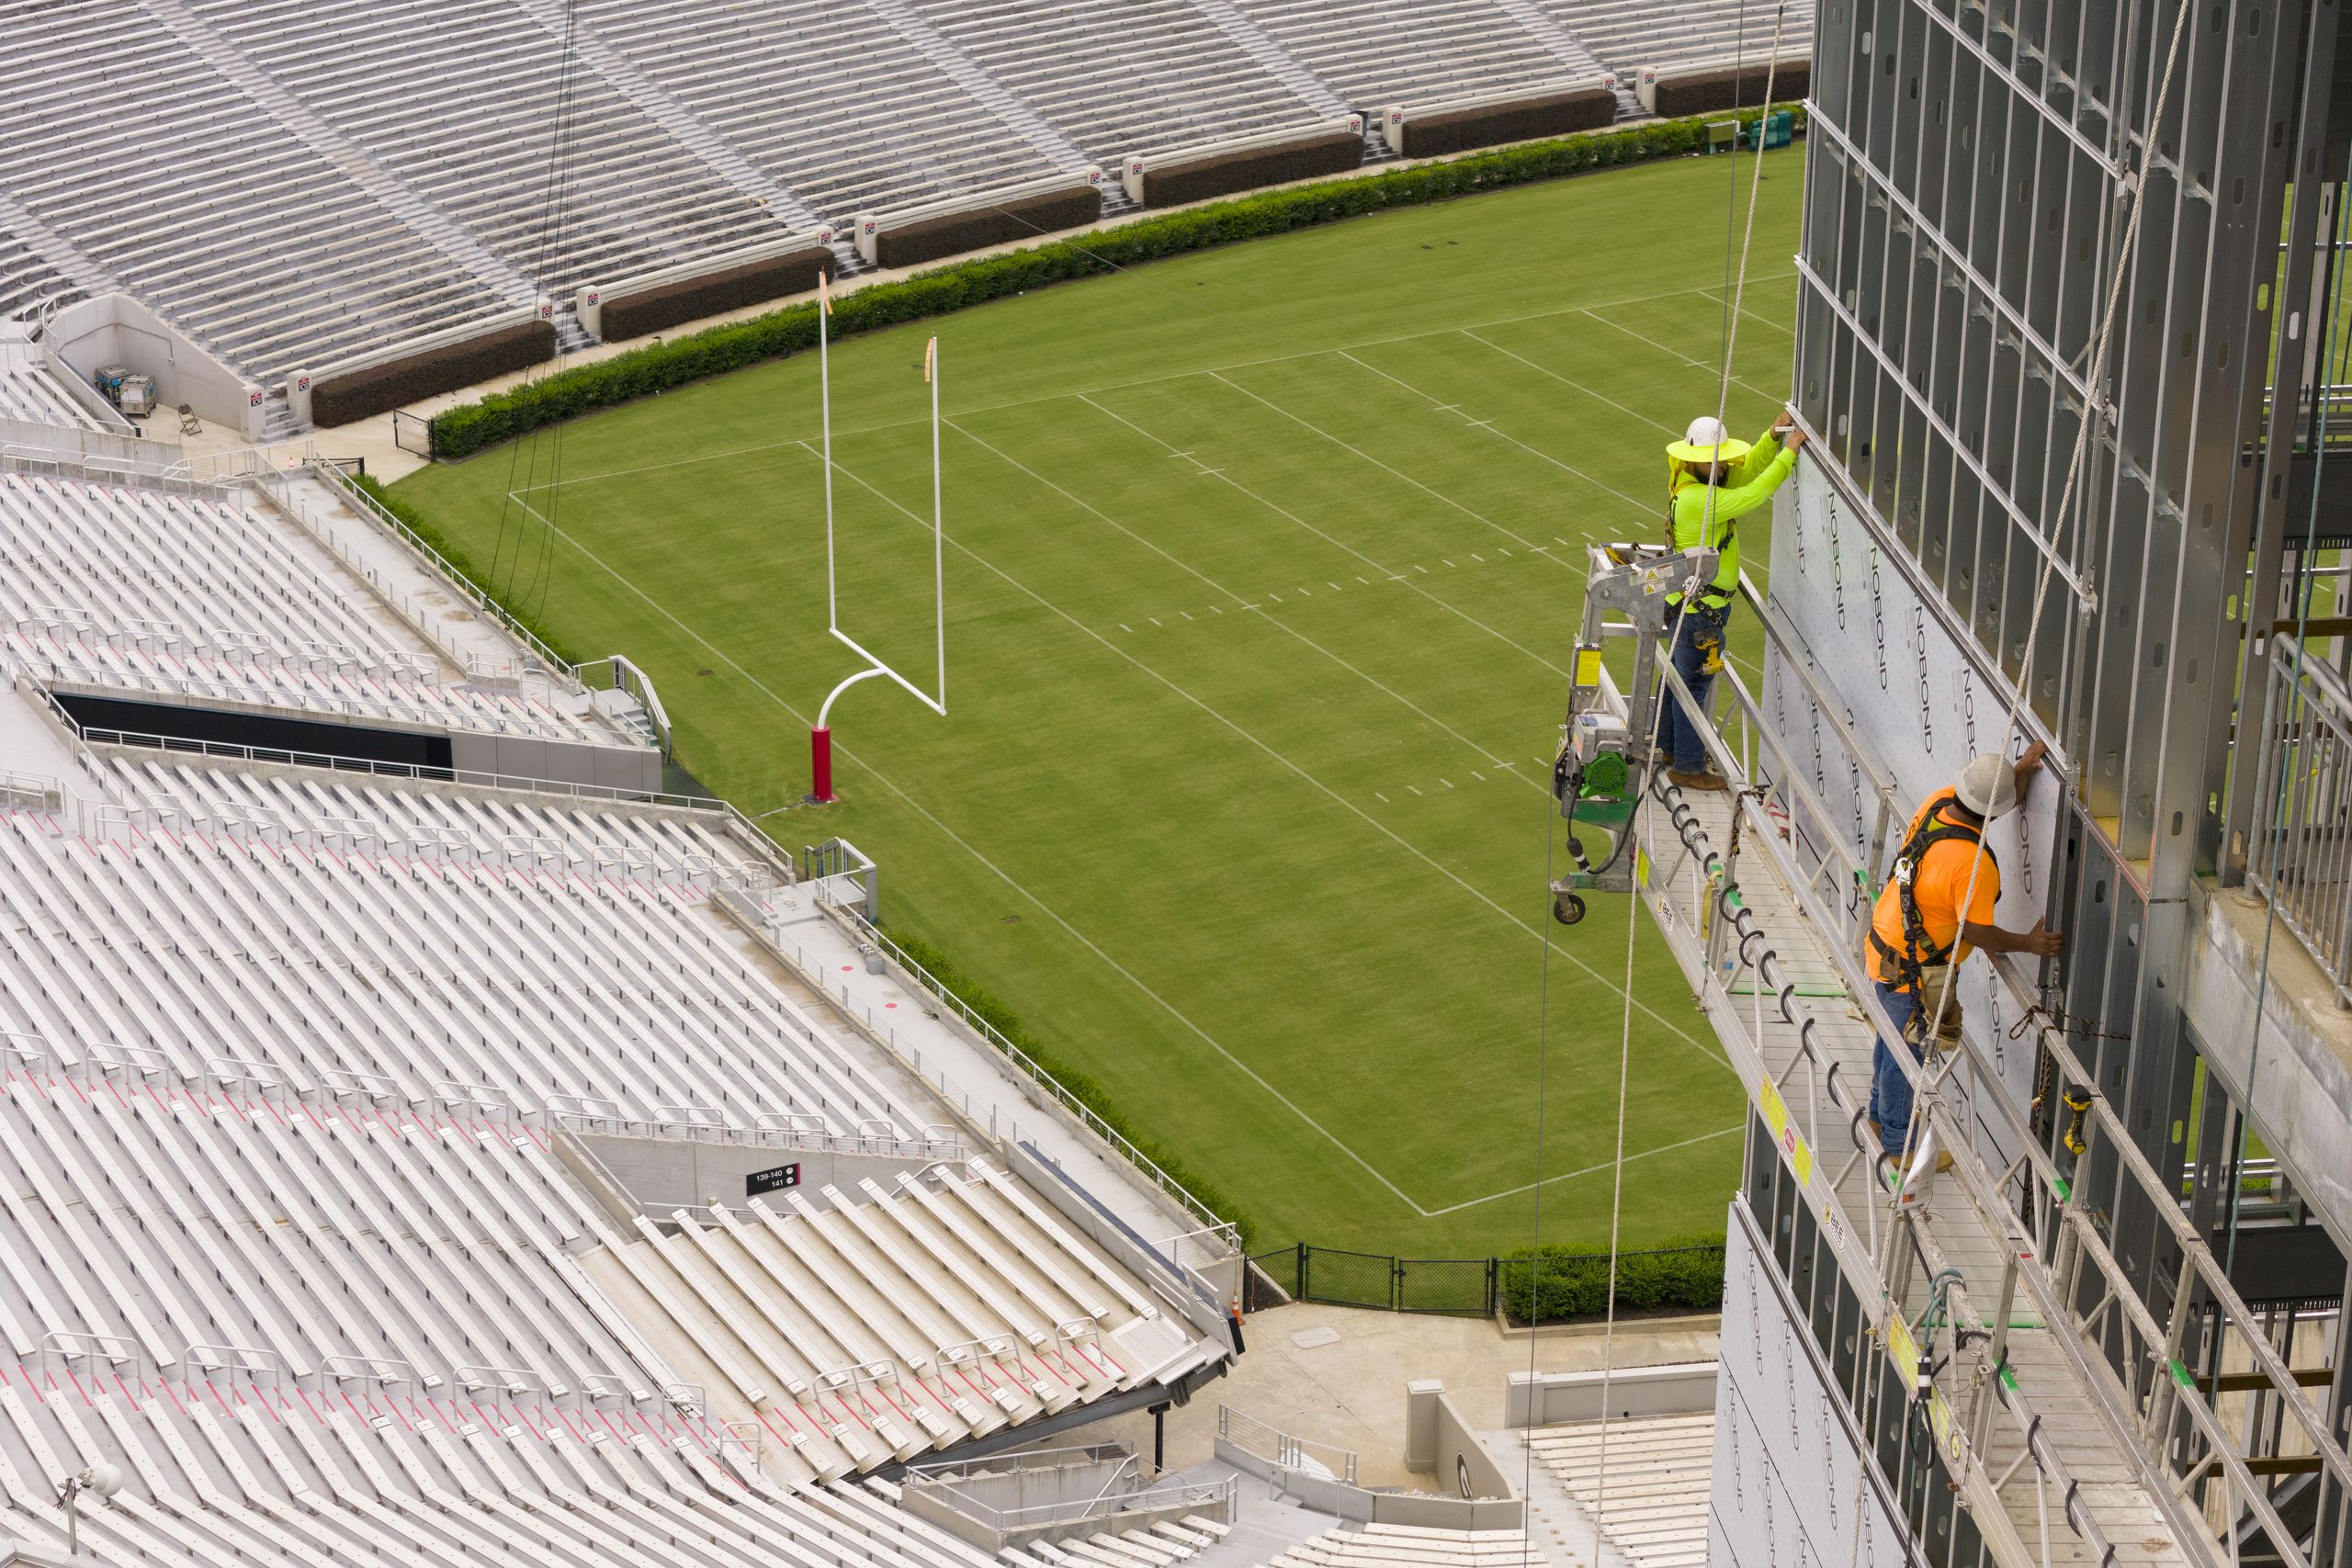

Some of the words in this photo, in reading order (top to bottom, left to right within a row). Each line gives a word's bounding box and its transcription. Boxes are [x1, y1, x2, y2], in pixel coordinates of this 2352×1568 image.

[1792, 462, 1805, 575] OBOND
[1827, 480, 1846, 631] NOBOND
[1870, 536, 1888, 691] NOBOND
[1915, 592, 1933, 754] NOBOND
[1962, 655, 1977, 761] NOBO
[756, 1169, 783, 1182] 139-140
[772, 1179, 784, 1188] 141
[1748, 1247, 1763, 1376] NOBOND
[1783, 1319, 1799, 1451] NOBOND
[1821, 1393, 1838, 1531] NOBOND
